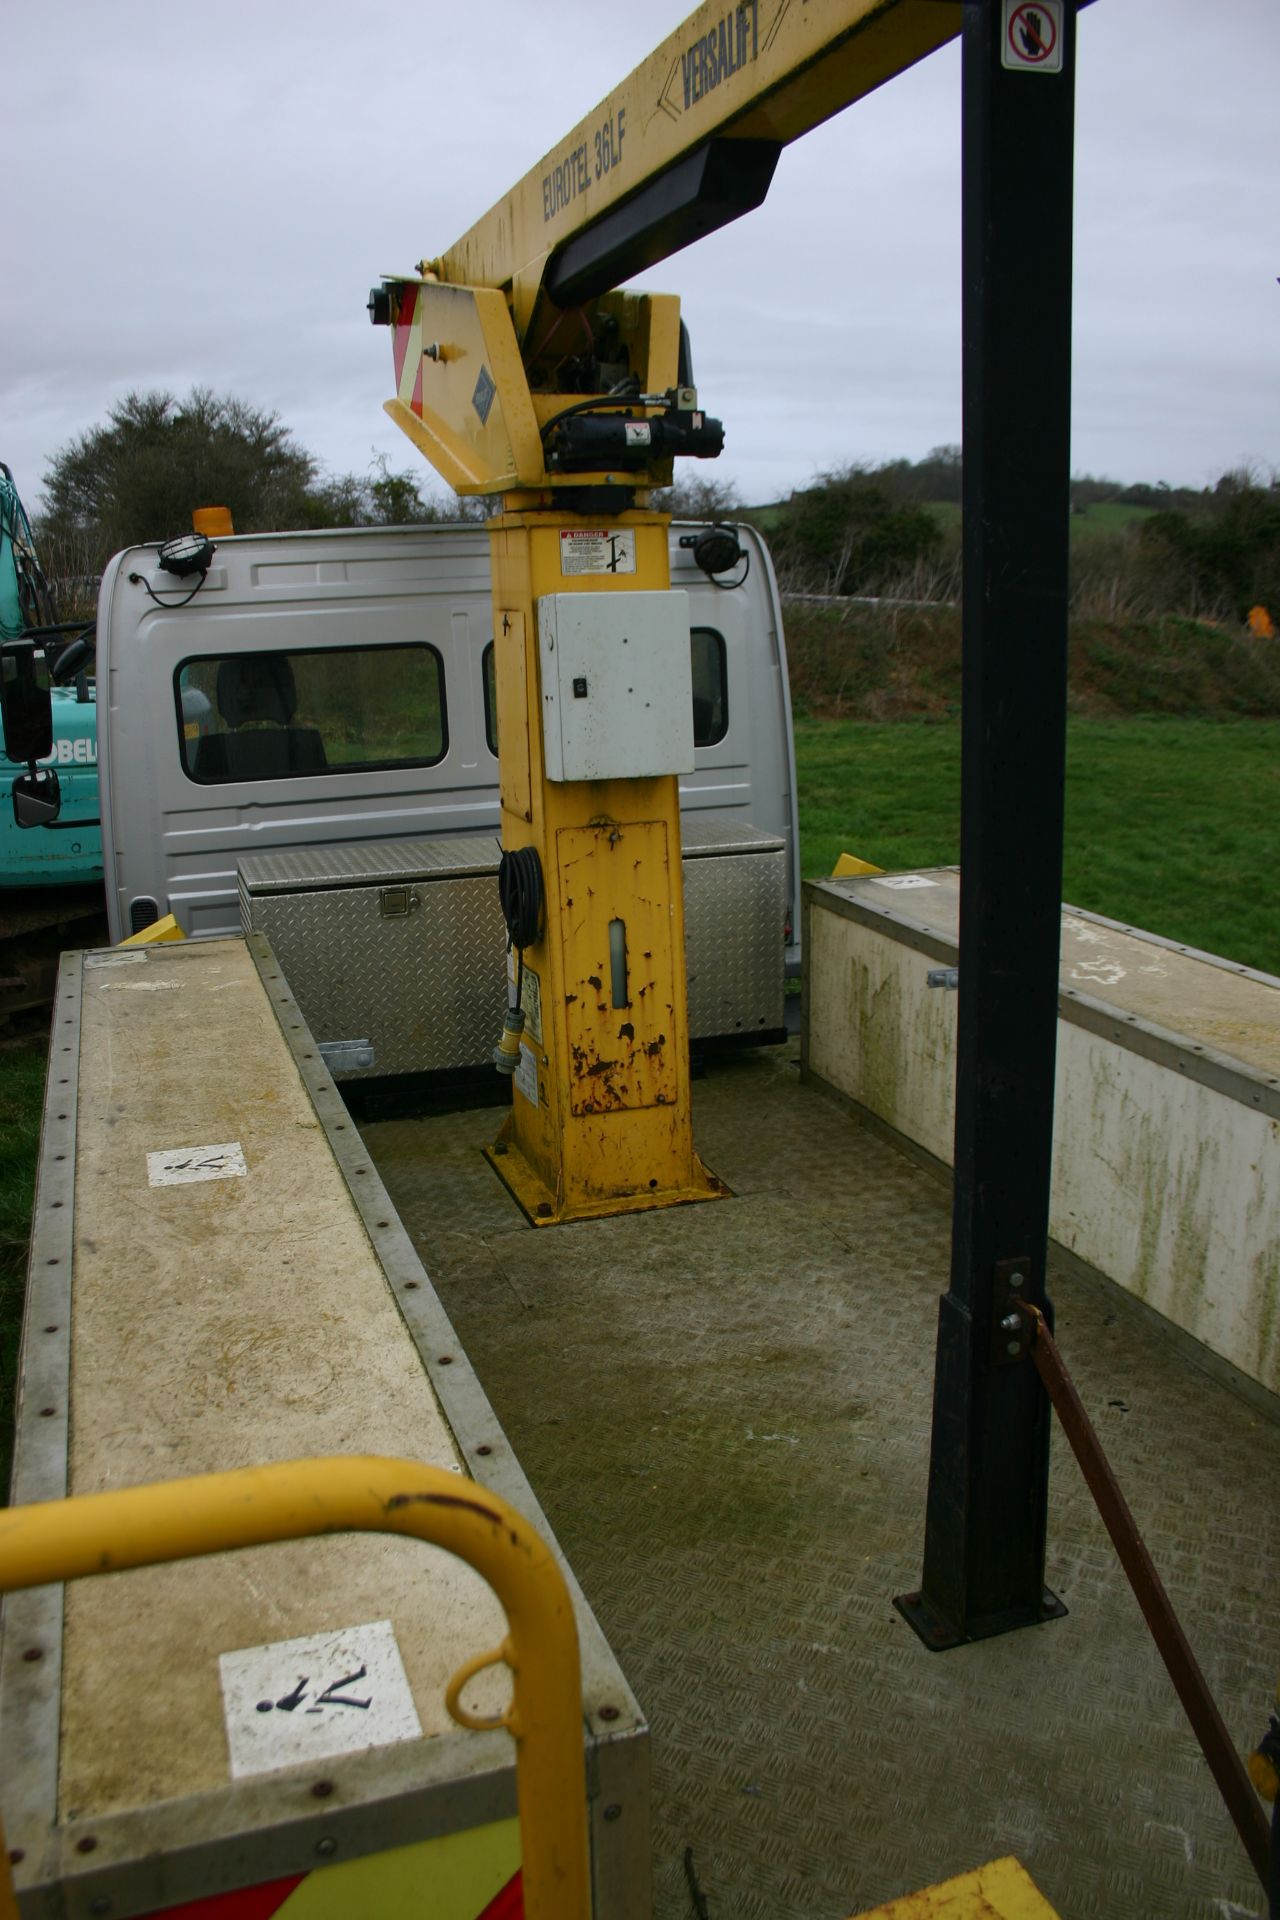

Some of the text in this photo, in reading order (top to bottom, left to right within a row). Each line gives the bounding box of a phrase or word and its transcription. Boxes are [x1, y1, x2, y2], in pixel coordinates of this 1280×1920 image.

[682, 0, 758, 111] VERSALIFT
[543, 108, 625, 223] EUROTEL 36LF
